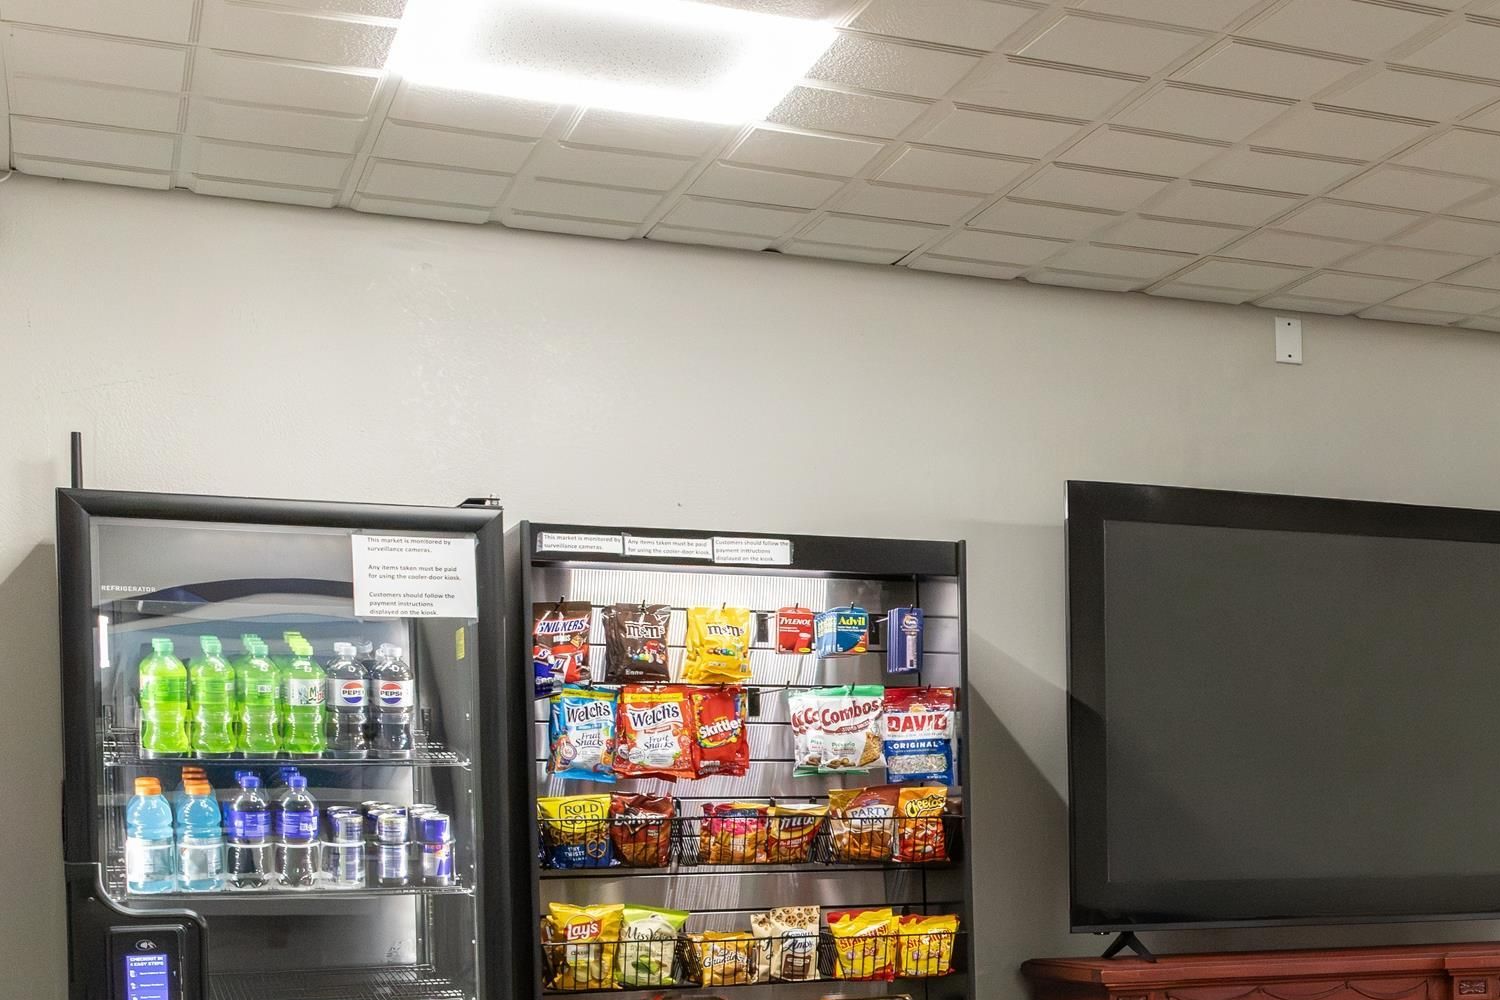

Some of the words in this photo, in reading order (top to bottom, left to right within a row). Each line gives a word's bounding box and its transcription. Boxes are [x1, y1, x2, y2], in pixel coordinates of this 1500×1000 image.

[101, 584, 156, 593] REFRIGERATOR
[780, 617, 811, 626] TYLENOL
[838, 615, 866, 626] Advil
[566, 701, 611, 723] Welch's
[630, 704, 680, 728] Welch's
[821, 699, 880, 727] Combos
[887, 713, 948, 733] DAVID
[581, 732, 601, 741] Fruit
[892, 741, 938, 750] ORIGINAL
[564, 802, 599, 815] ROLD
[850, 806, 890, 818] PARTY
[905, 795, 946, 818] Cheetos
[567, 921, 599, 941] Lay's
